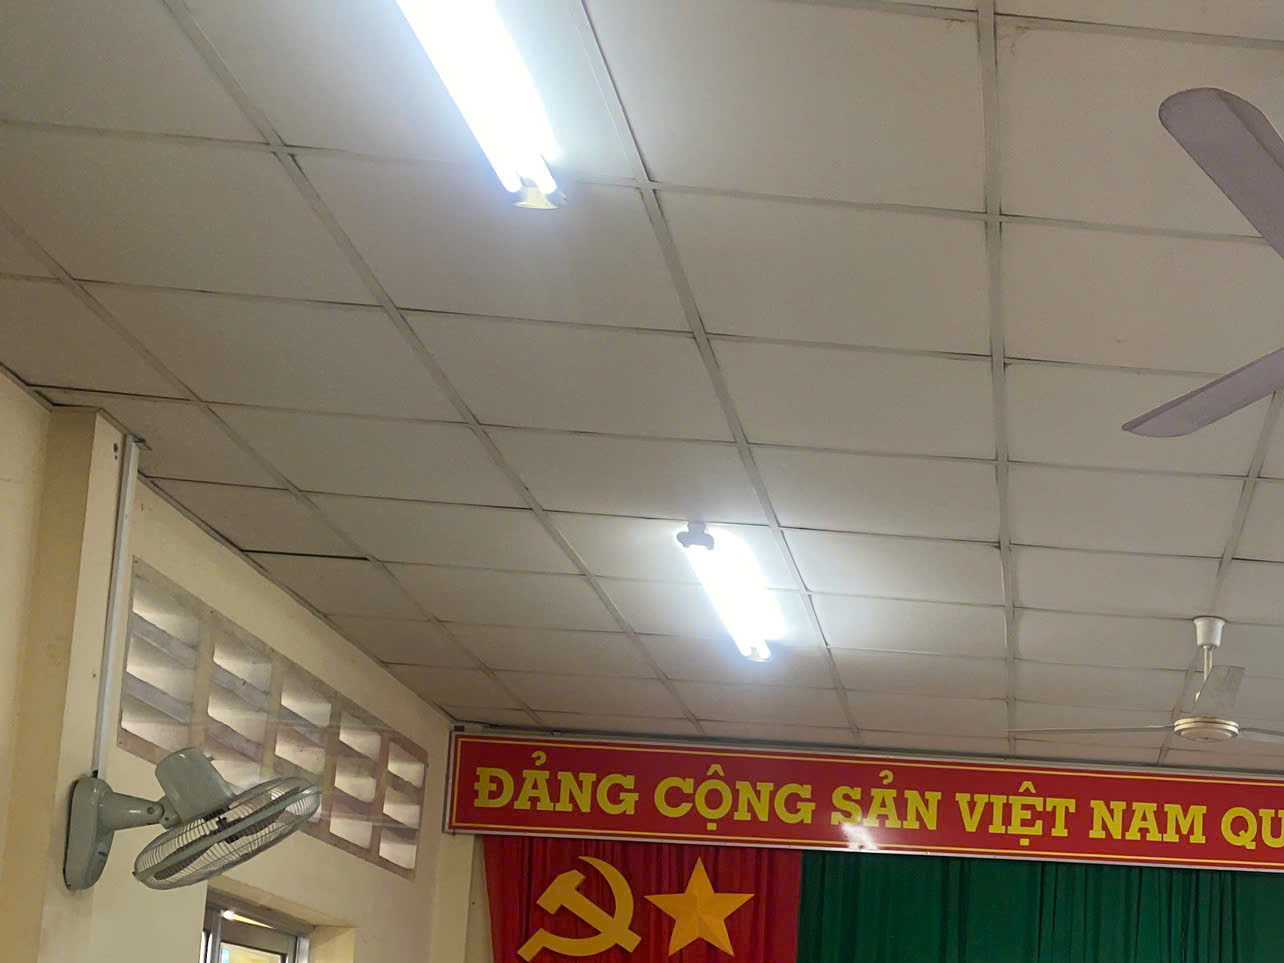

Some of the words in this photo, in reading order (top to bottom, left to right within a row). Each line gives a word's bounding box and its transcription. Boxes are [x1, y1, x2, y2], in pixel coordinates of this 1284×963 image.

[474, 750, 639, 815] ĐẢNG
[653, 763, 816, 830] CỘNG
[831, 769, 942, 831] SẢN
[955, 781, 1076, 846] VIỆT
[1089, 800, 1207, 844] NAM
